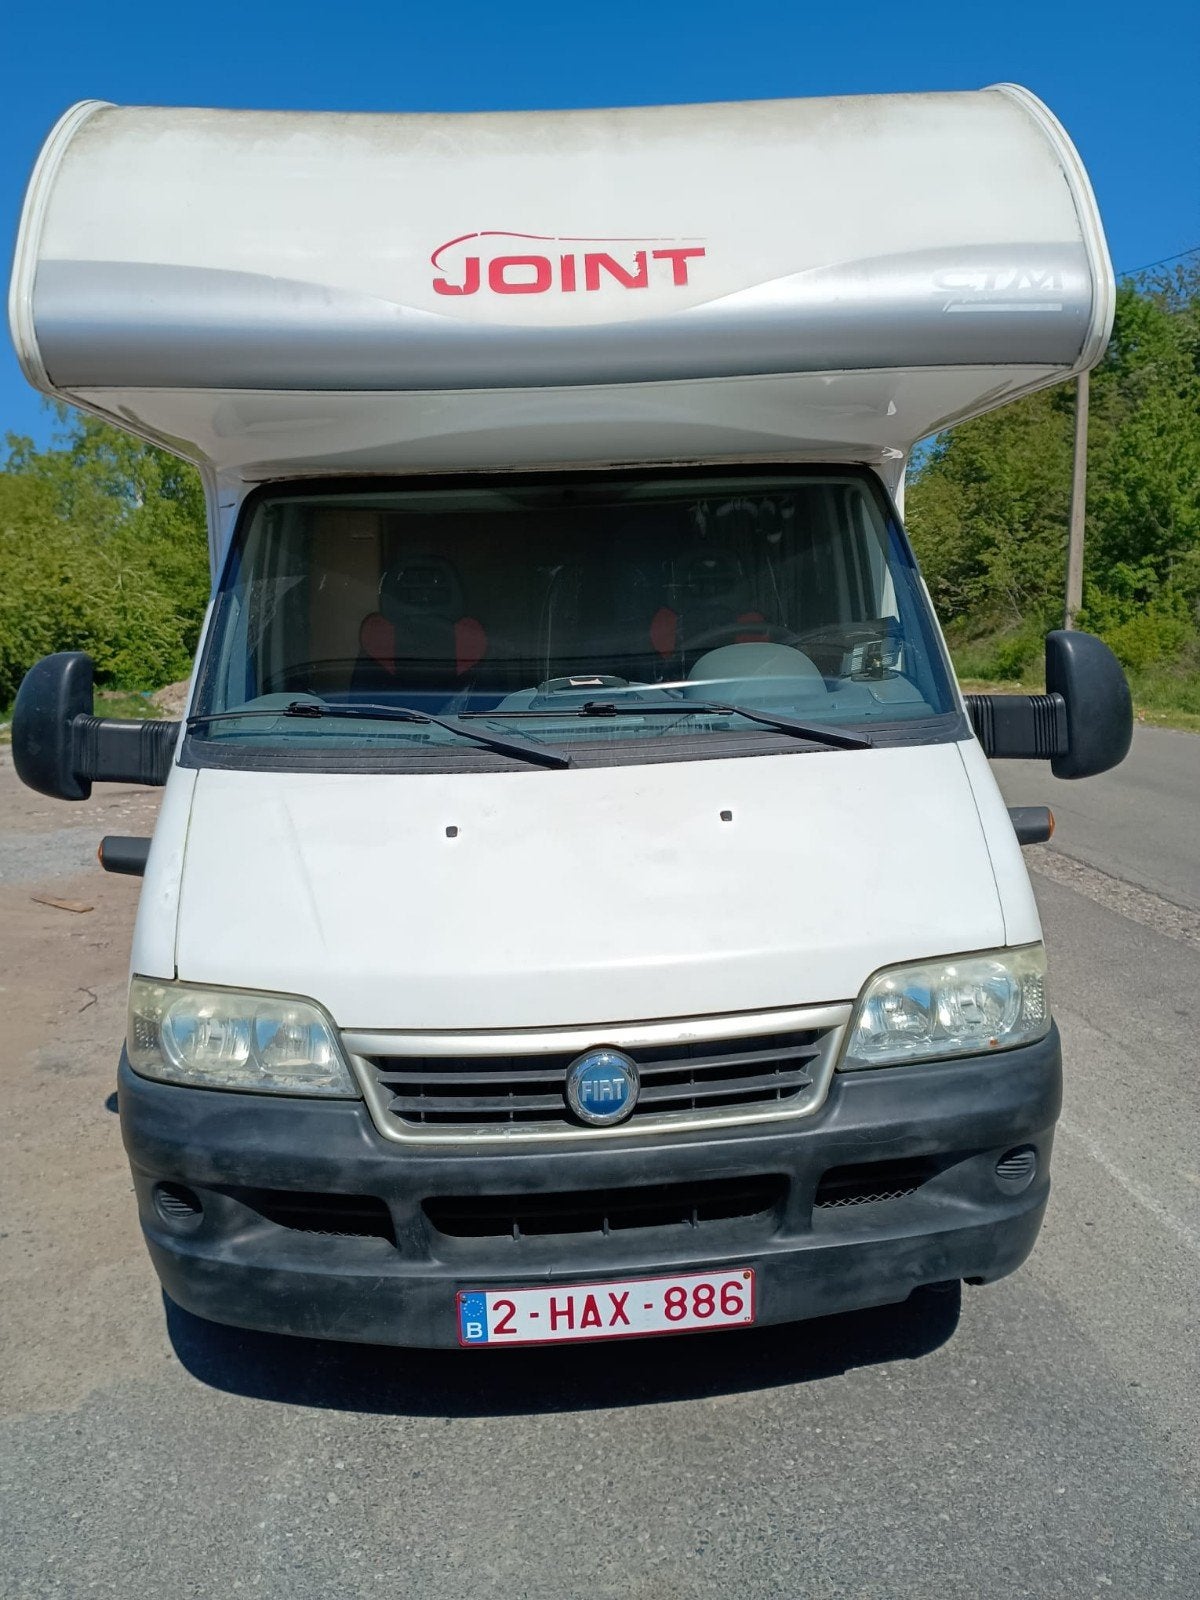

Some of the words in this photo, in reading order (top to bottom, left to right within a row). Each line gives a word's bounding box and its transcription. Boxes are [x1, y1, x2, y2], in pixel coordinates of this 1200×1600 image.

[432, 247, 706, 296] JOINT
[581, 1078, 625, 1102] FIAT
[466, 1322, 483, 1339] B
